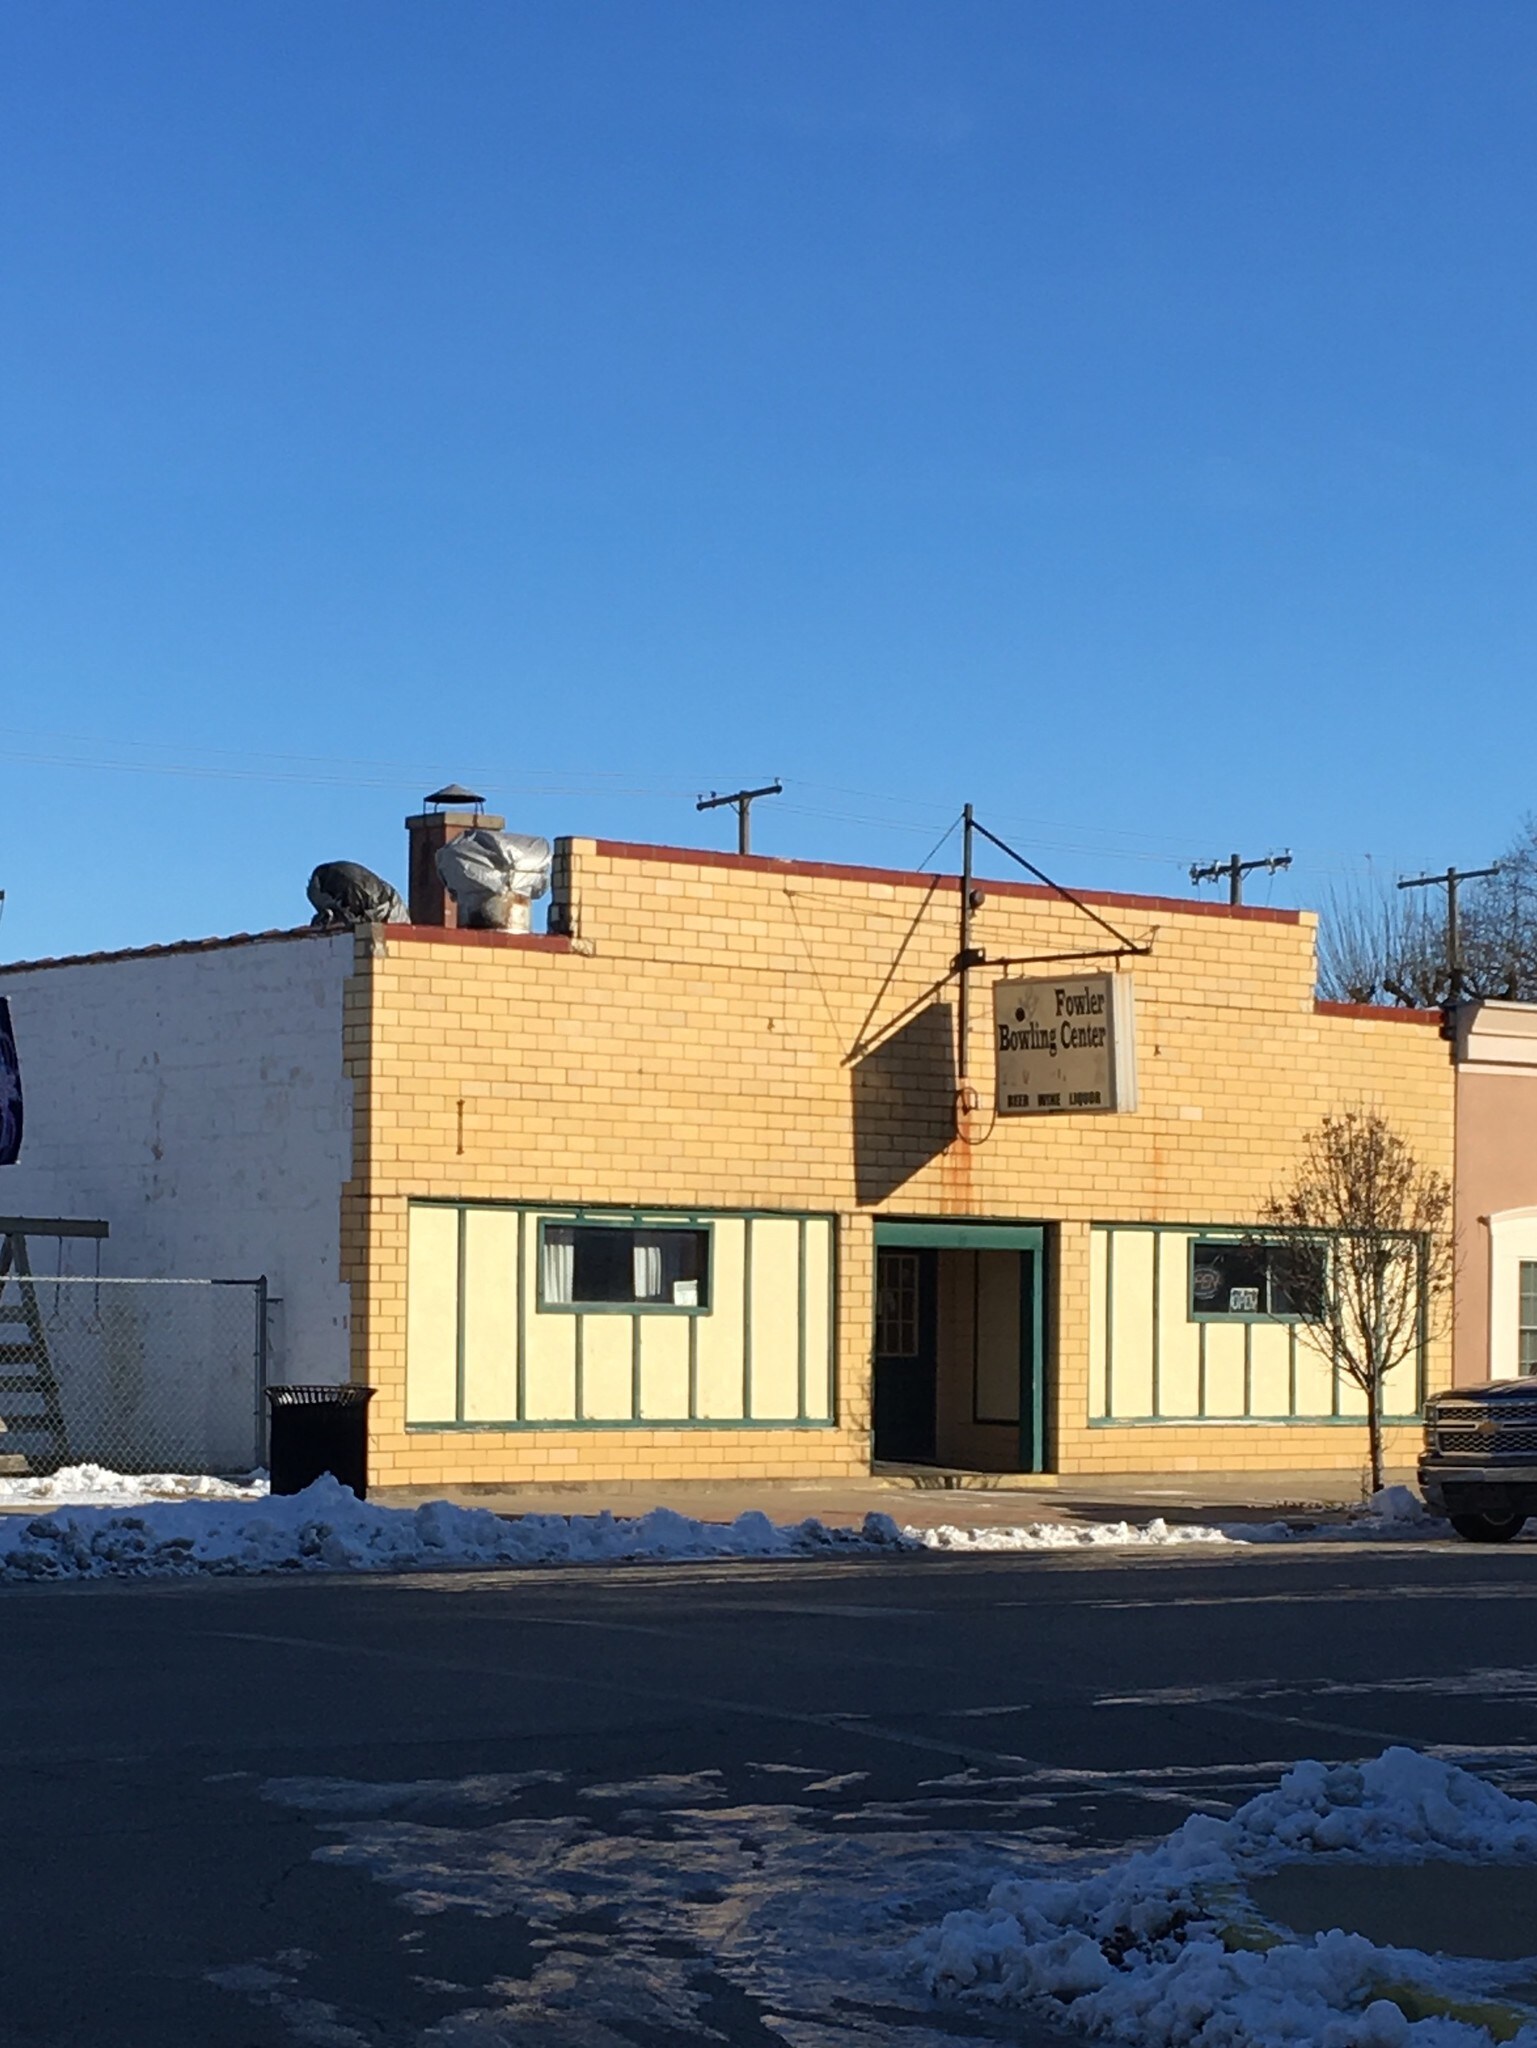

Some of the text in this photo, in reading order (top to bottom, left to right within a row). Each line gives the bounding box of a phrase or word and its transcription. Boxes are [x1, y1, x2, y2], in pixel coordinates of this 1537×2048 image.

[1055, 986, 1105, 1017] Fowler
[998, 1020, 1106, 1057] Bowling Center
[1007, 1094, 1029, 1108] BEER
[1069, 1091, 1101, 1106] LIQUOR
